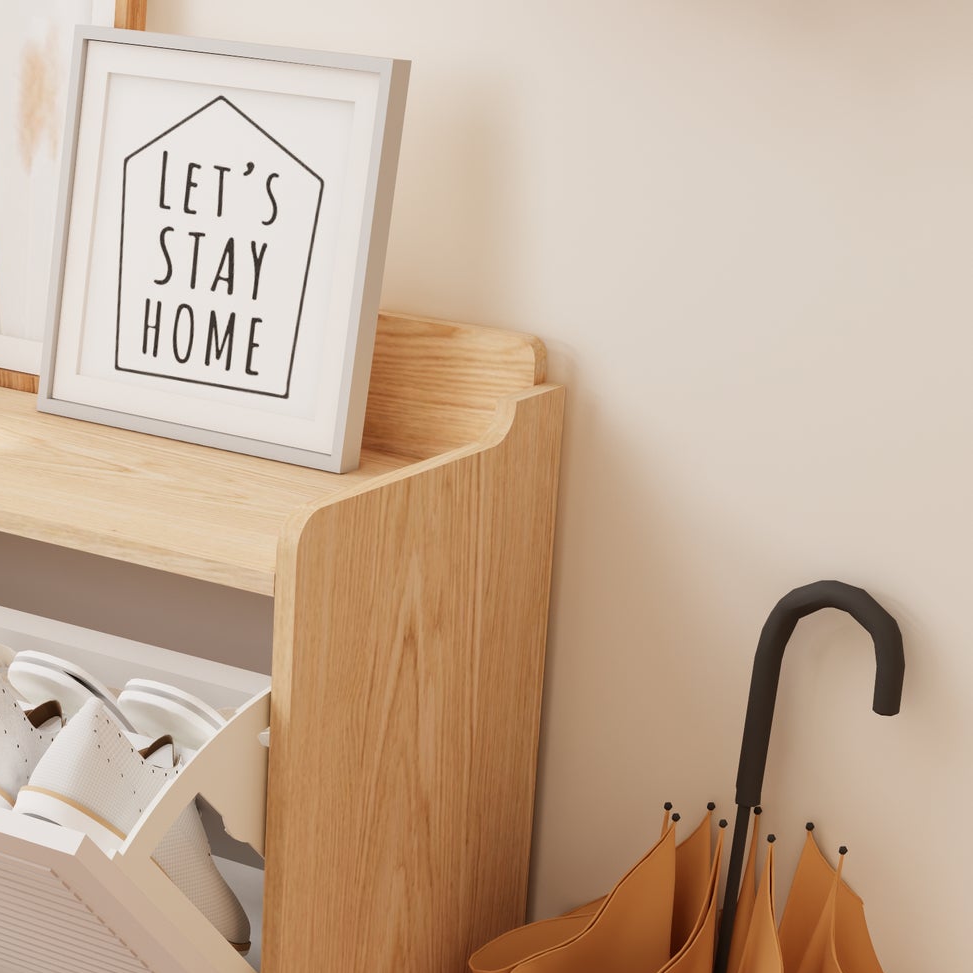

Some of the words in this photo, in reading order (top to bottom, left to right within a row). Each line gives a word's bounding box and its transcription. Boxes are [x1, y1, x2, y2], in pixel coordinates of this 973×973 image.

[159, 150, 280, 226] LET’S
[153, 226, 268, 300] STAY
[142, 298, 264, 376] HOME
